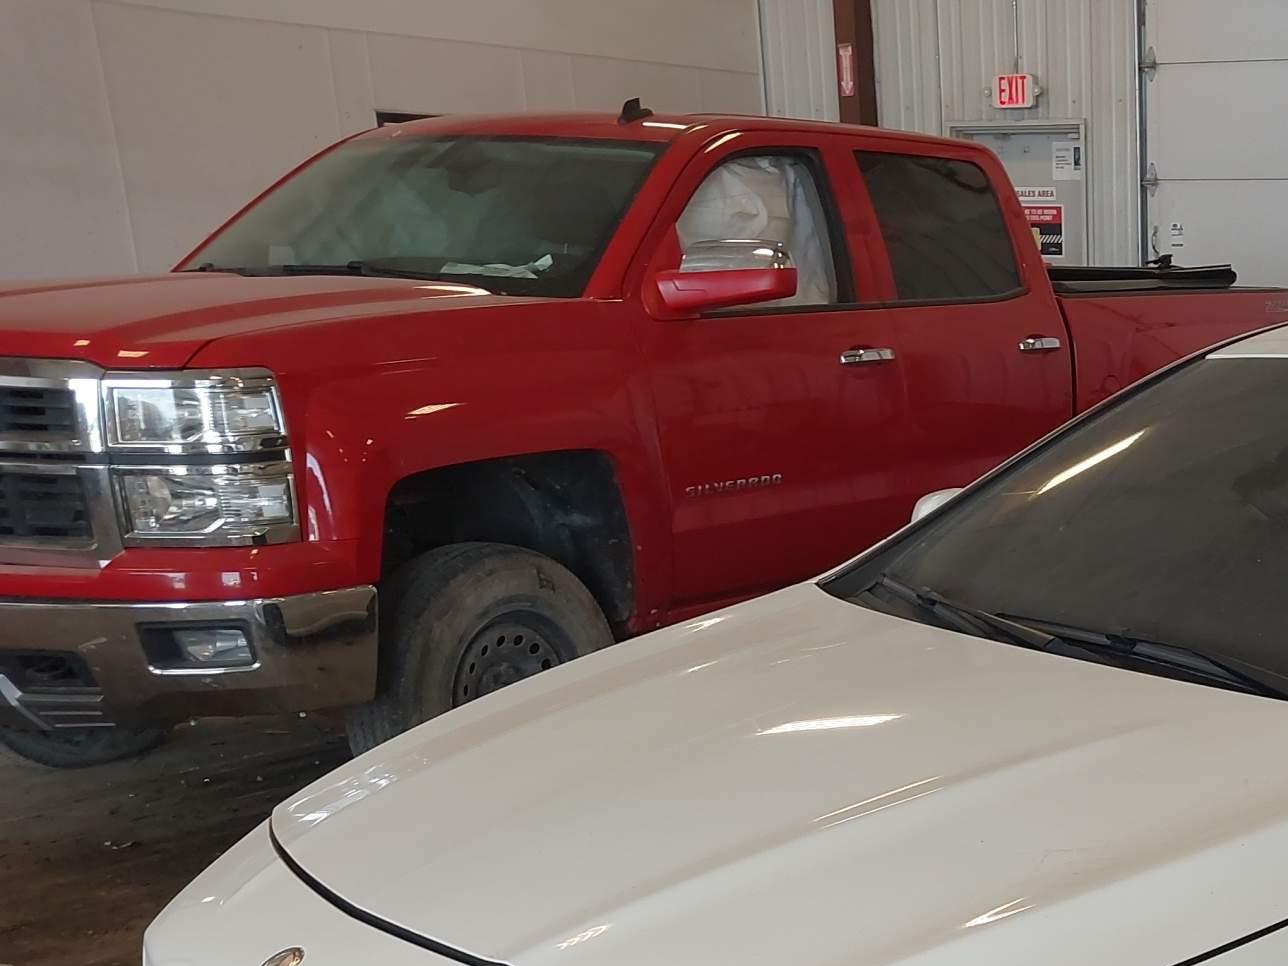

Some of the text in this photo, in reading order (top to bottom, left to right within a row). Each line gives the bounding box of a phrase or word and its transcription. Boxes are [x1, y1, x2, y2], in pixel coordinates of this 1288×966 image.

[998, 76, 1027, 105] EXIT
[1038, 190, 1055, 198] AREA
[685, 473, 782, 497] SILVERADO
